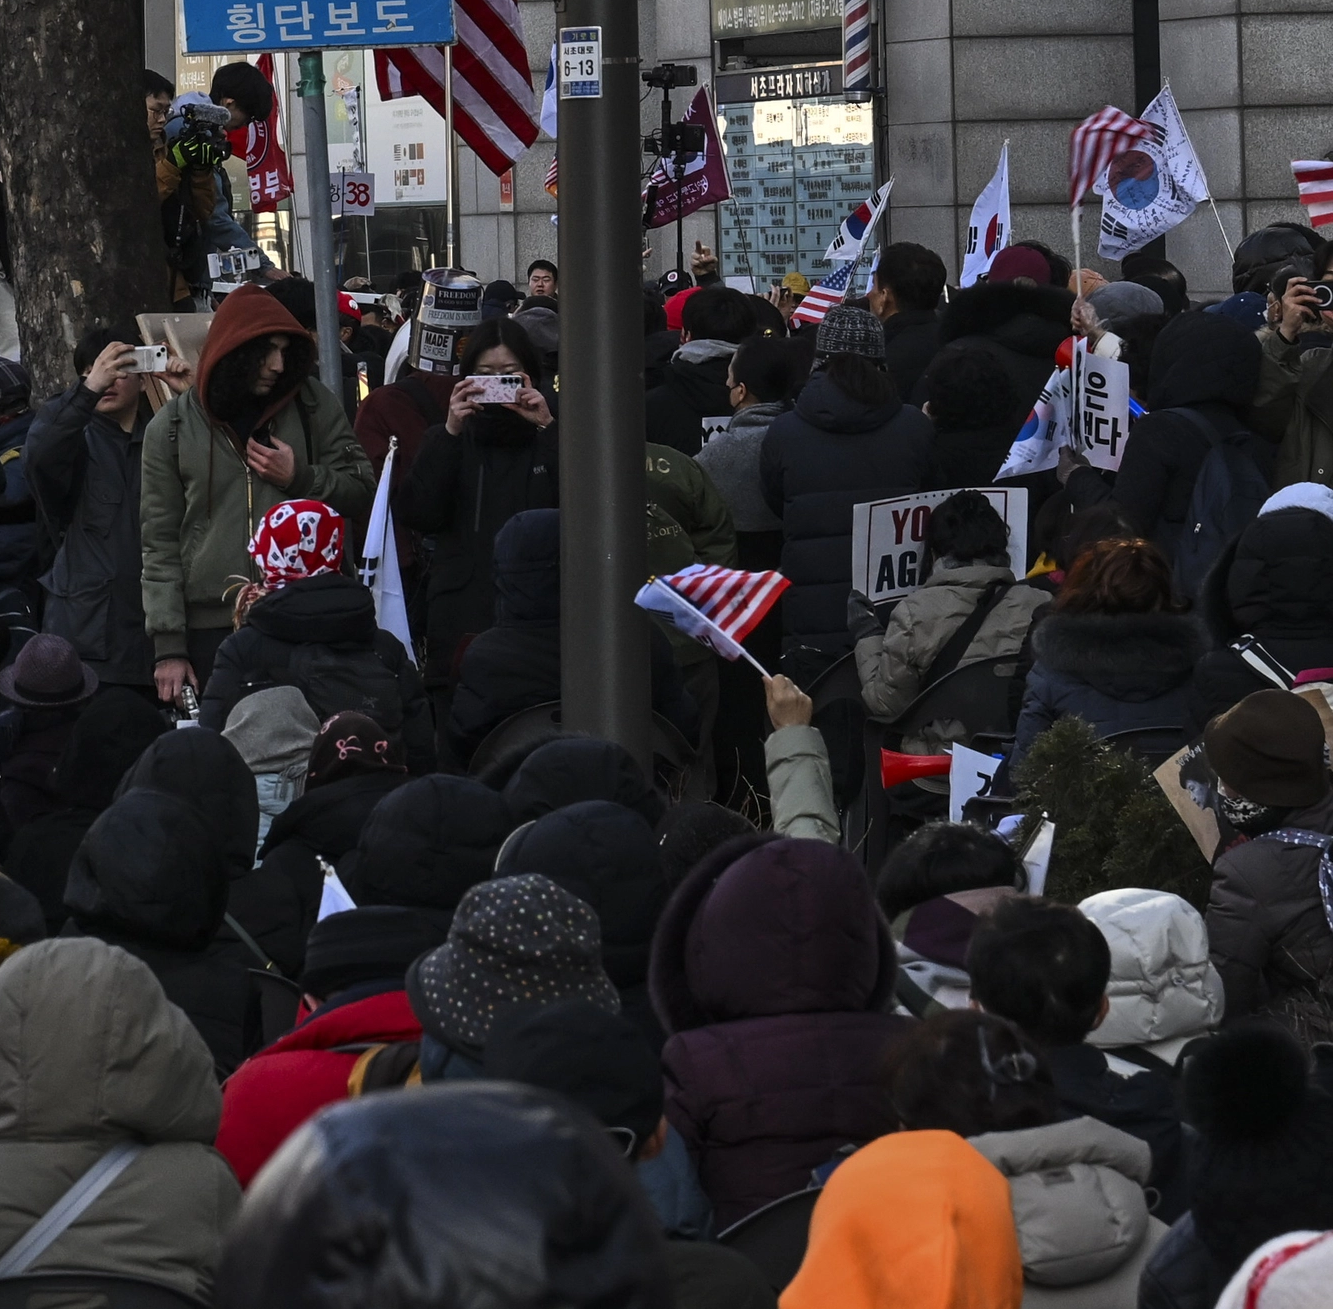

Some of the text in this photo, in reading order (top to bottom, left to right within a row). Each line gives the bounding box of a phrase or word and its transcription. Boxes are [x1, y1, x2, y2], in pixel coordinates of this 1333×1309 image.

[226, 0, 414, 44] 횡단보도
[563, 45, 595, 55] 서초대로
[564, 59, 594, 77] 6-13
[750, 74, 794, 99] 서초프라자
[425, 332, 450, 348] MADE
